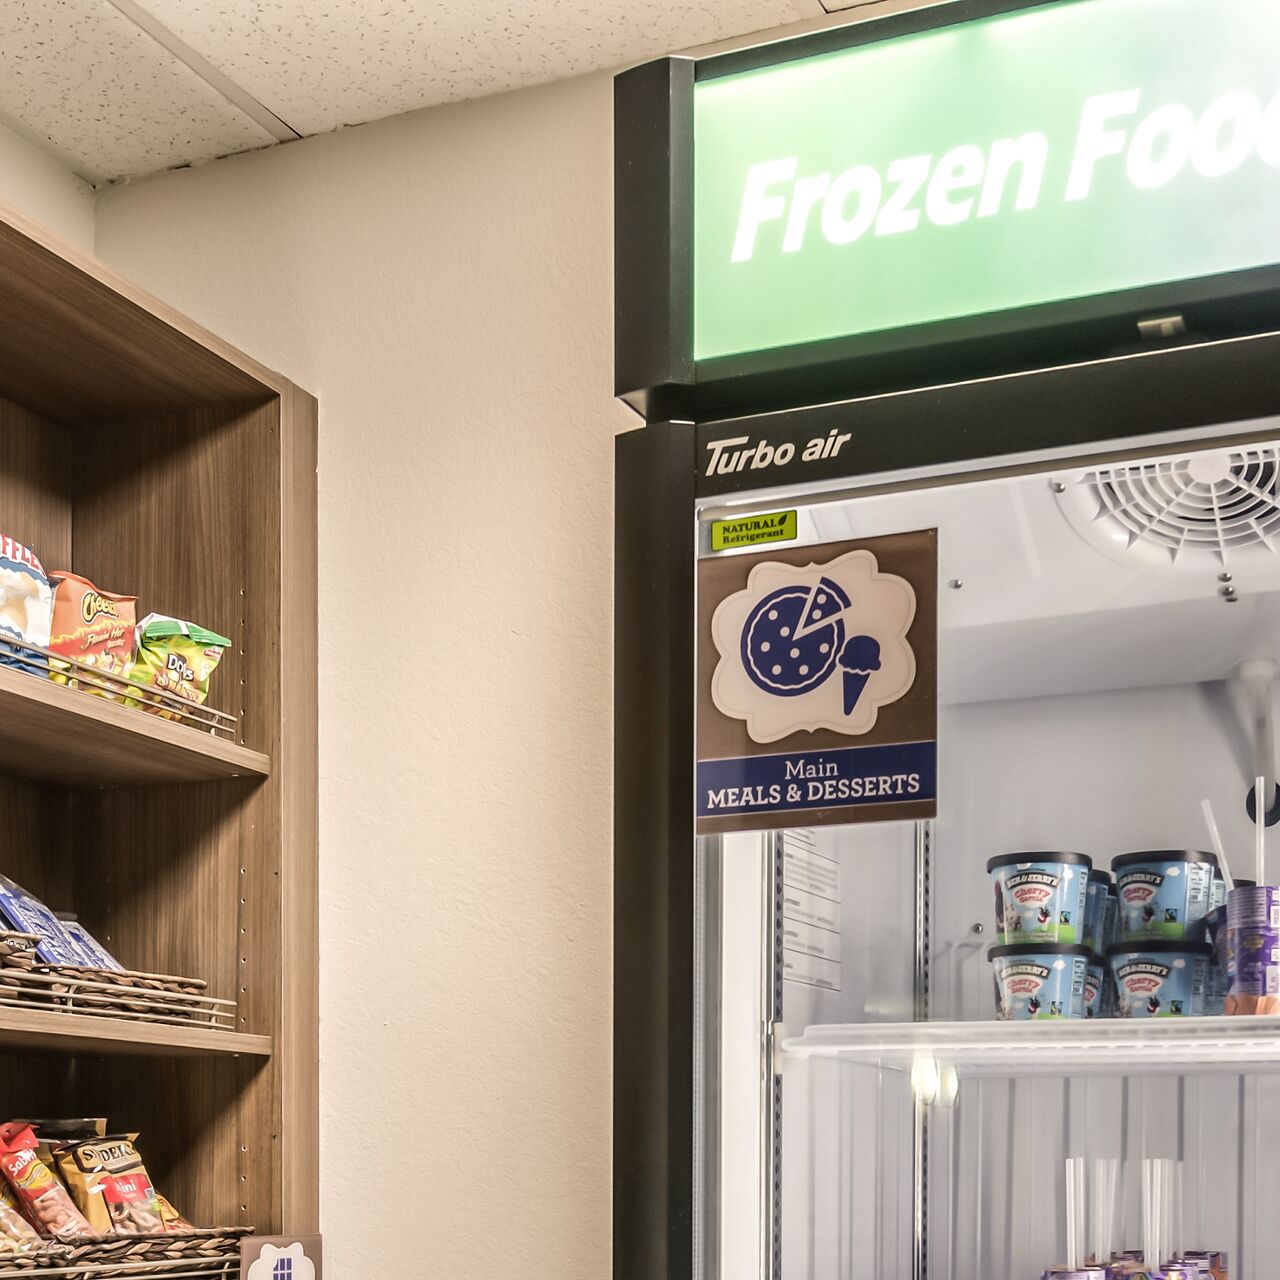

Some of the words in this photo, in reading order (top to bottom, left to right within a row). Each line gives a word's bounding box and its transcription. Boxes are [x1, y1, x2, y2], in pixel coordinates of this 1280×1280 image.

[730, 129, 1048, 264] Frozen
[705, 436, 795, 476] Turbo
[802, 429, 852, 459] air
[722, 519, 778, 535] NATURAL
[722, 528, 785, 545] Refrigerant
[785, 760, 839, 780] Main
[707, 784, 780, 809] MEALS
[787, 783, 802, 802] &
[807, 774, 920, 800] DESSERTS
